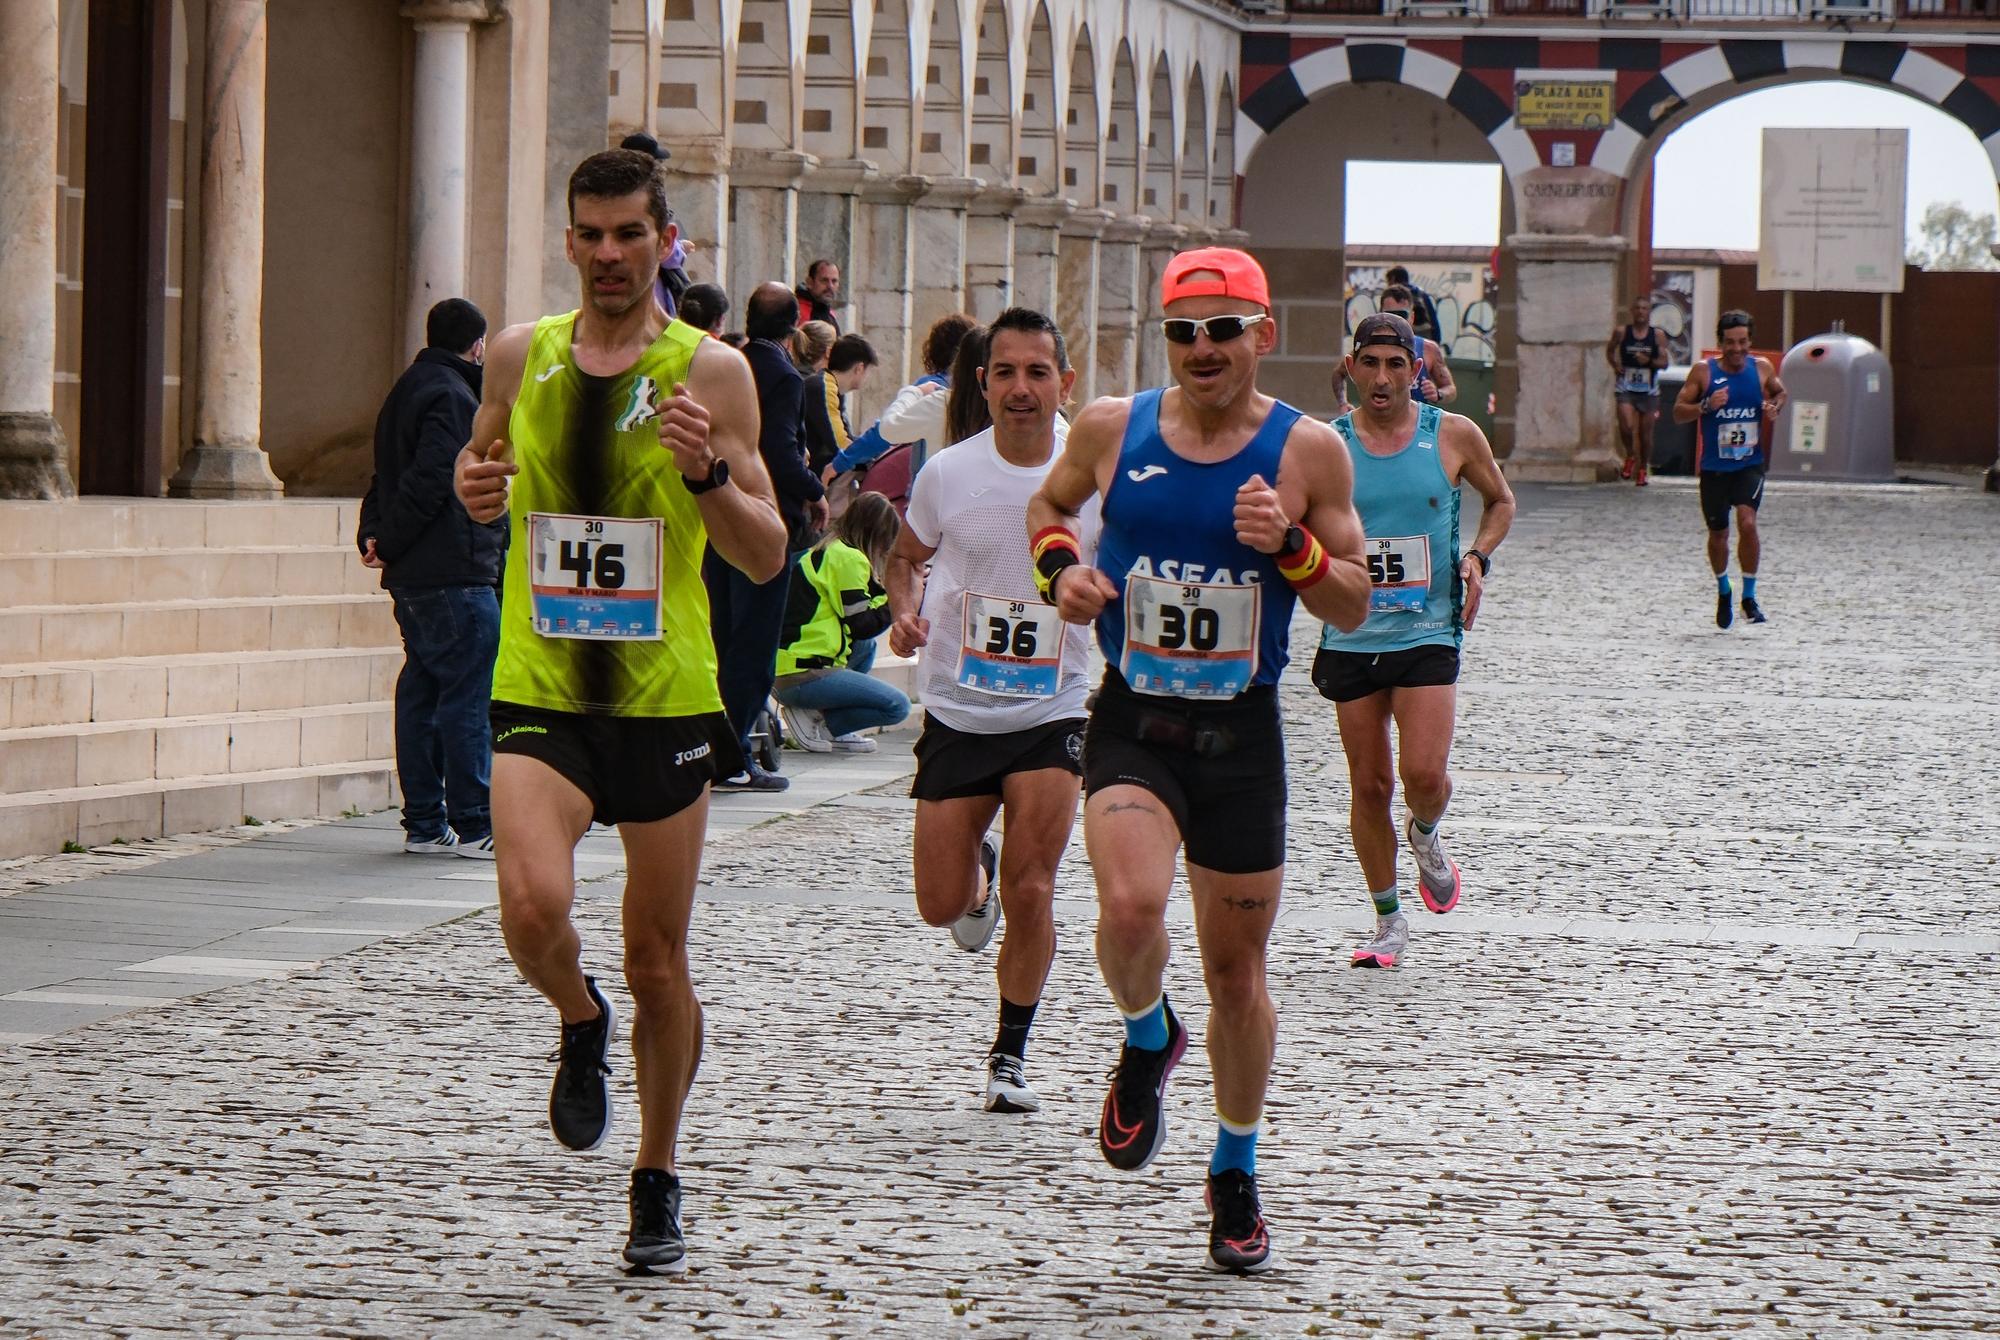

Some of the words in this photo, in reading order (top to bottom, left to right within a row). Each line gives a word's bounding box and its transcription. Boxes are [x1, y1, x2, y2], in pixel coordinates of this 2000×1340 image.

[1534, 86, 1571, 98] PLAZA
[1577, 87, 1604, 98] ALTA
[1715, 408, 1756, 419] ASFAS
[1731, 431, 1746, 446] 23
[585, 520, 604, 534] 30
[1377, 540, 1391, 549] 30
[560, 541, 625, 589] 46
[1366, 553, 1405, 583] 55
[1182, 587, 1201, 599] 30
[1009, 602, 1025, 613] 30
[1158, 604, 1219, 651] 30
[1412, 622, 1444, 630] ATHLETE
[985, 616, 1038, 658] 36
